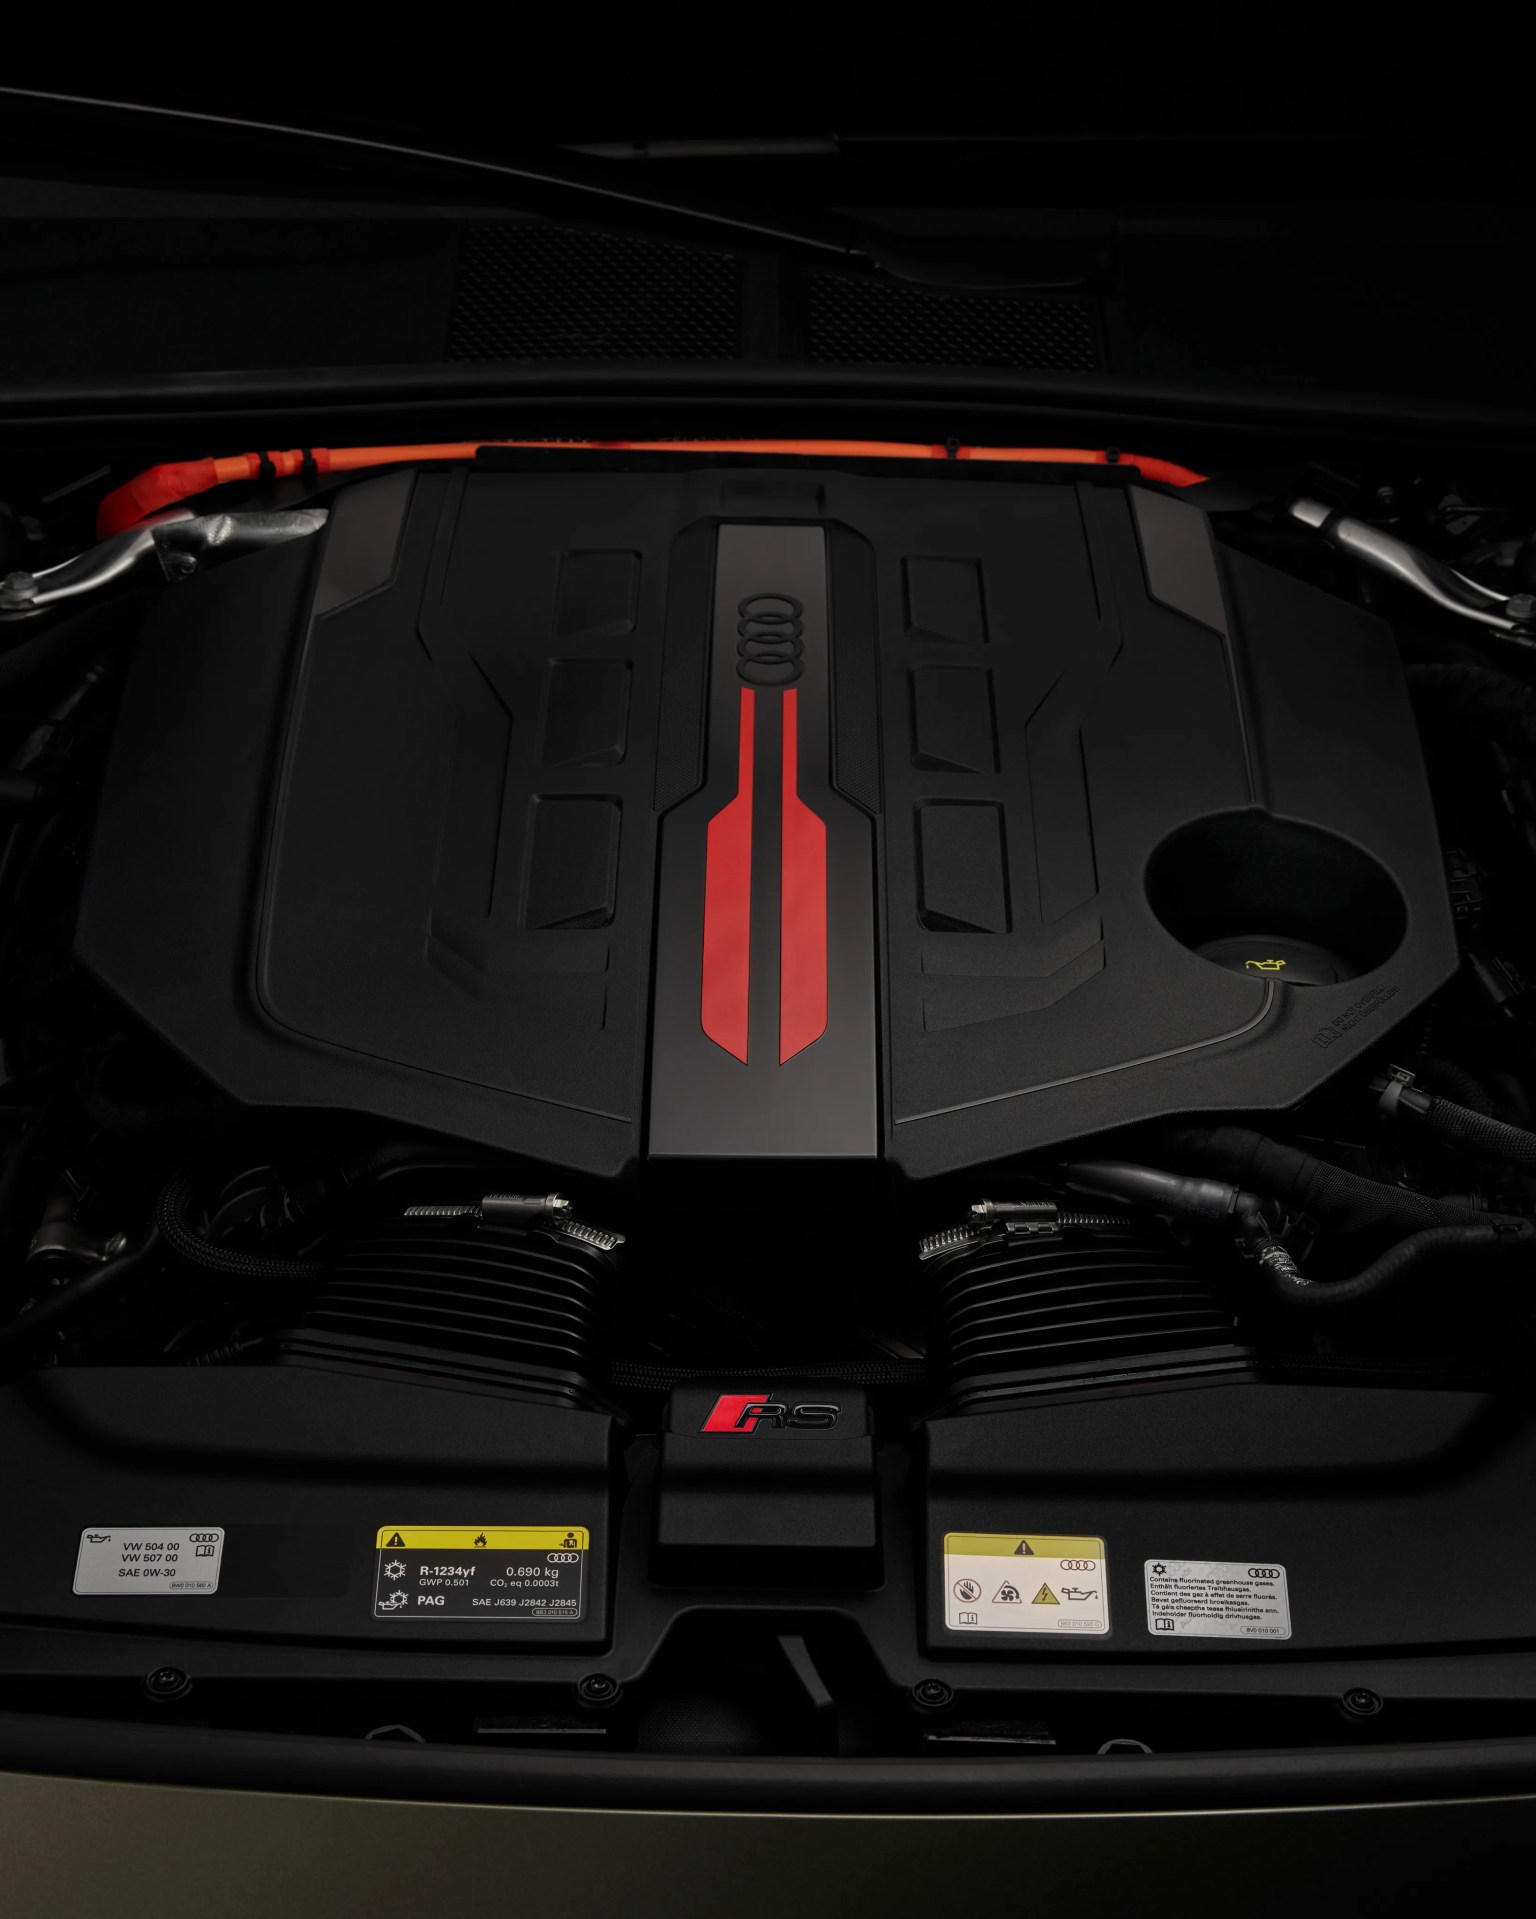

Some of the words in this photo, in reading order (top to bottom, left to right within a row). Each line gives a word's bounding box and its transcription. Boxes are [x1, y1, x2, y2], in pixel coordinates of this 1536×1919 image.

[733, 1400, 842, 1431] RS
[123, 1543, 142, 1551] VW
[145, 1543, 164, 1551] 504
[167, 1543, 180, 1551] 00
[122, 1554, 141, 1562] VW
[143, 1554, 162, 1562] 507
[165, 1554, 178, 1562] 00
[118, 1569, 140, 1577] SAE
[143, 1569, 176, 1577] 0W-30
[419, 1566, 476, 1578] R-1234yf
[506, 1567, 540, 1577] 0.690
[545, 1567, 559, 1578] kg
[417, 1595, 445, 1606] PAG
[472, 1598, 491, 1606] SAE
[519, 1599, 547, 1607] J2842
[549, 1599, 577, 1607] J2845
[1171, 1597, 1208, 1605] gefluoreerd
[1210, 1598, 1249, 1606] broeikasgas.
